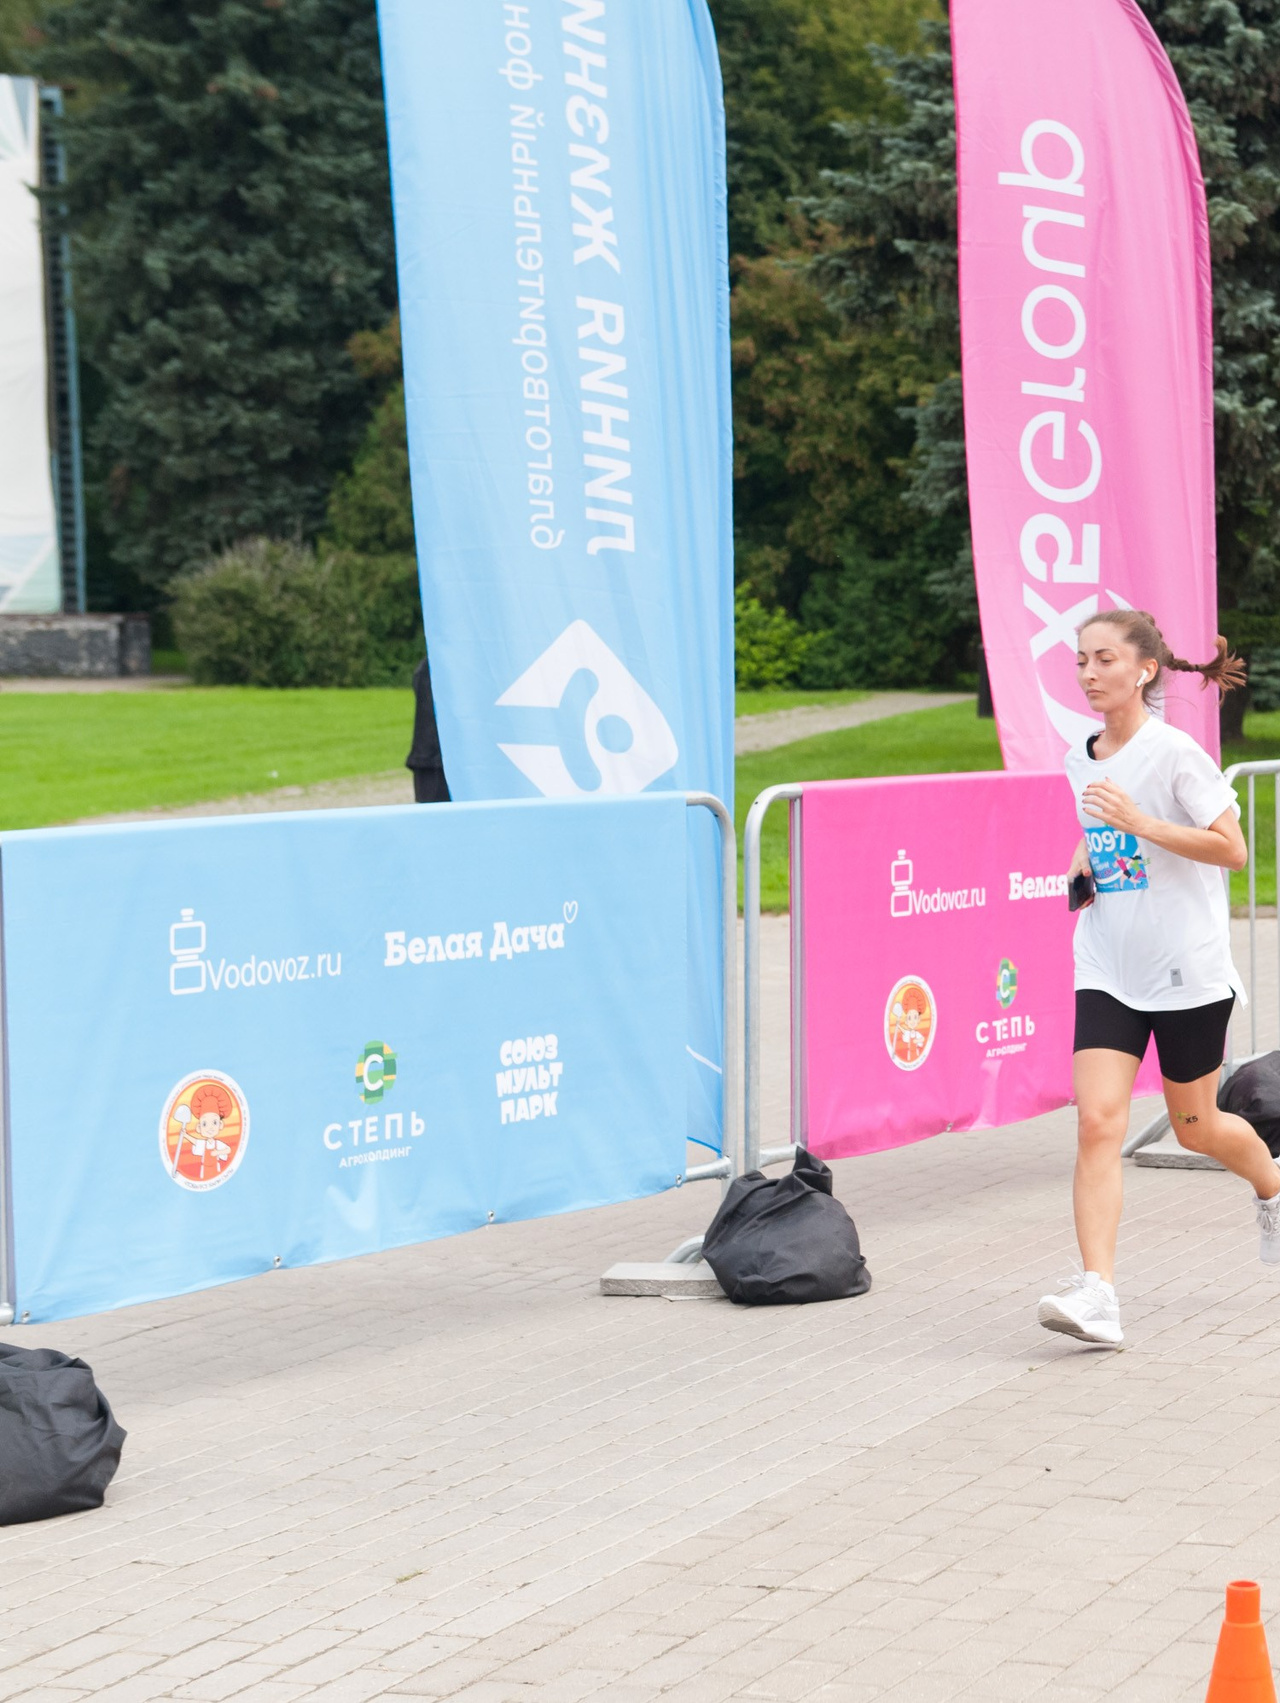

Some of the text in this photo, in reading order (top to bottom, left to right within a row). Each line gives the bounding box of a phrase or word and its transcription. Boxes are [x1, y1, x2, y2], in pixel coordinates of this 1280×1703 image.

[1085, 831, 1126, 853] 3097
[912, 887, 986, 914] Vodovoz.ru
[383, 921, 565, 967] Белая Дача
[206, 952, 342, 991] Vodovoz.ru
[975, 1014, 1036, 1044] СТЕПЬ
[499, 1033, 559, 1067] СОЮЗ
[495, 1062, 564, 1098] МУЛЬТ
[500, 1091, 559, 1125] ПАРК
[1185, 1114, 1199, 1125] X5
[323, 1111, 426, 1151] СТЕПЬ
[338, 1145, 412, 1168] АГРОХОЛДИНГ
